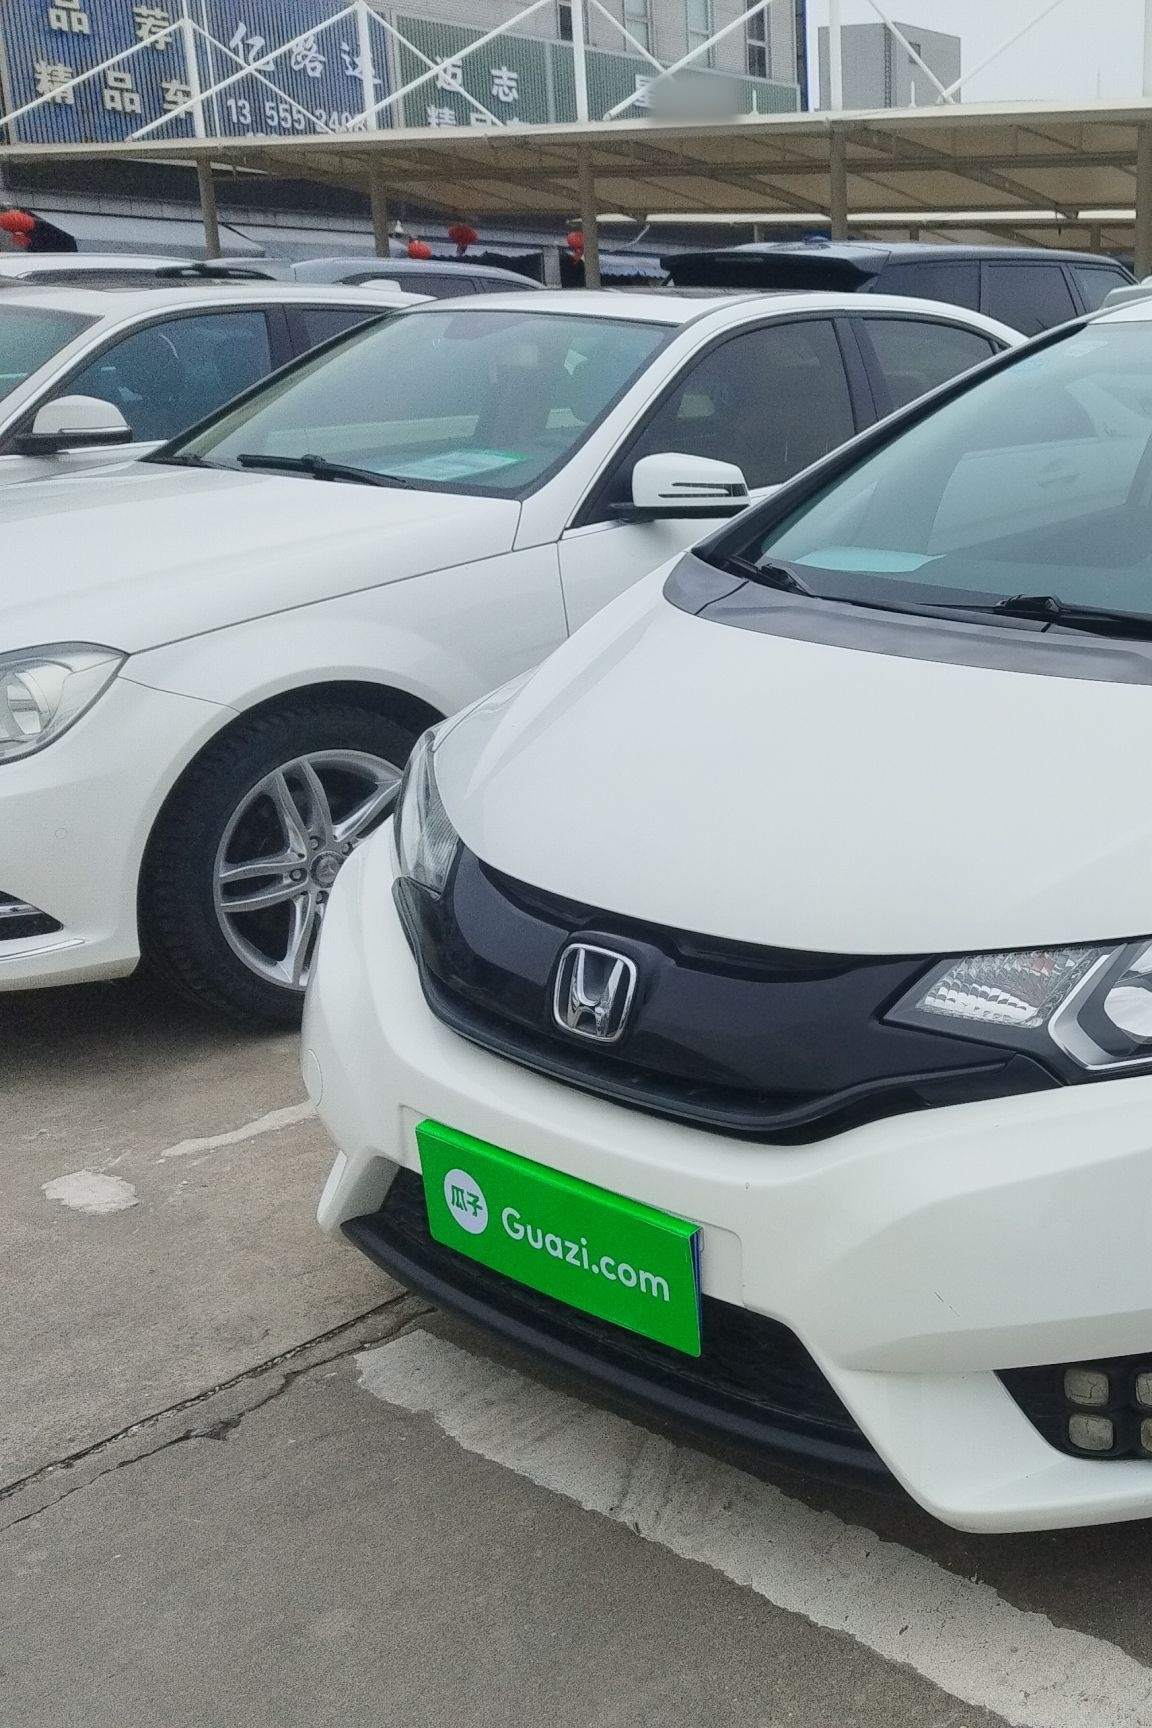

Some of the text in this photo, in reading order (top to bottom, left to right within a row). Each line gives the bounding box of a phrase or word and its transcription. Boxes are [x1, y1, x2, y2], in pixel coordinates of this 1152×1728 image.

[226, 98, 252, 125] 13
[264, 101, 306, 131] 555
[450, 1183, 483, 1217] 瓜子
[501, 1206, 671, 1302] Guazi.com
